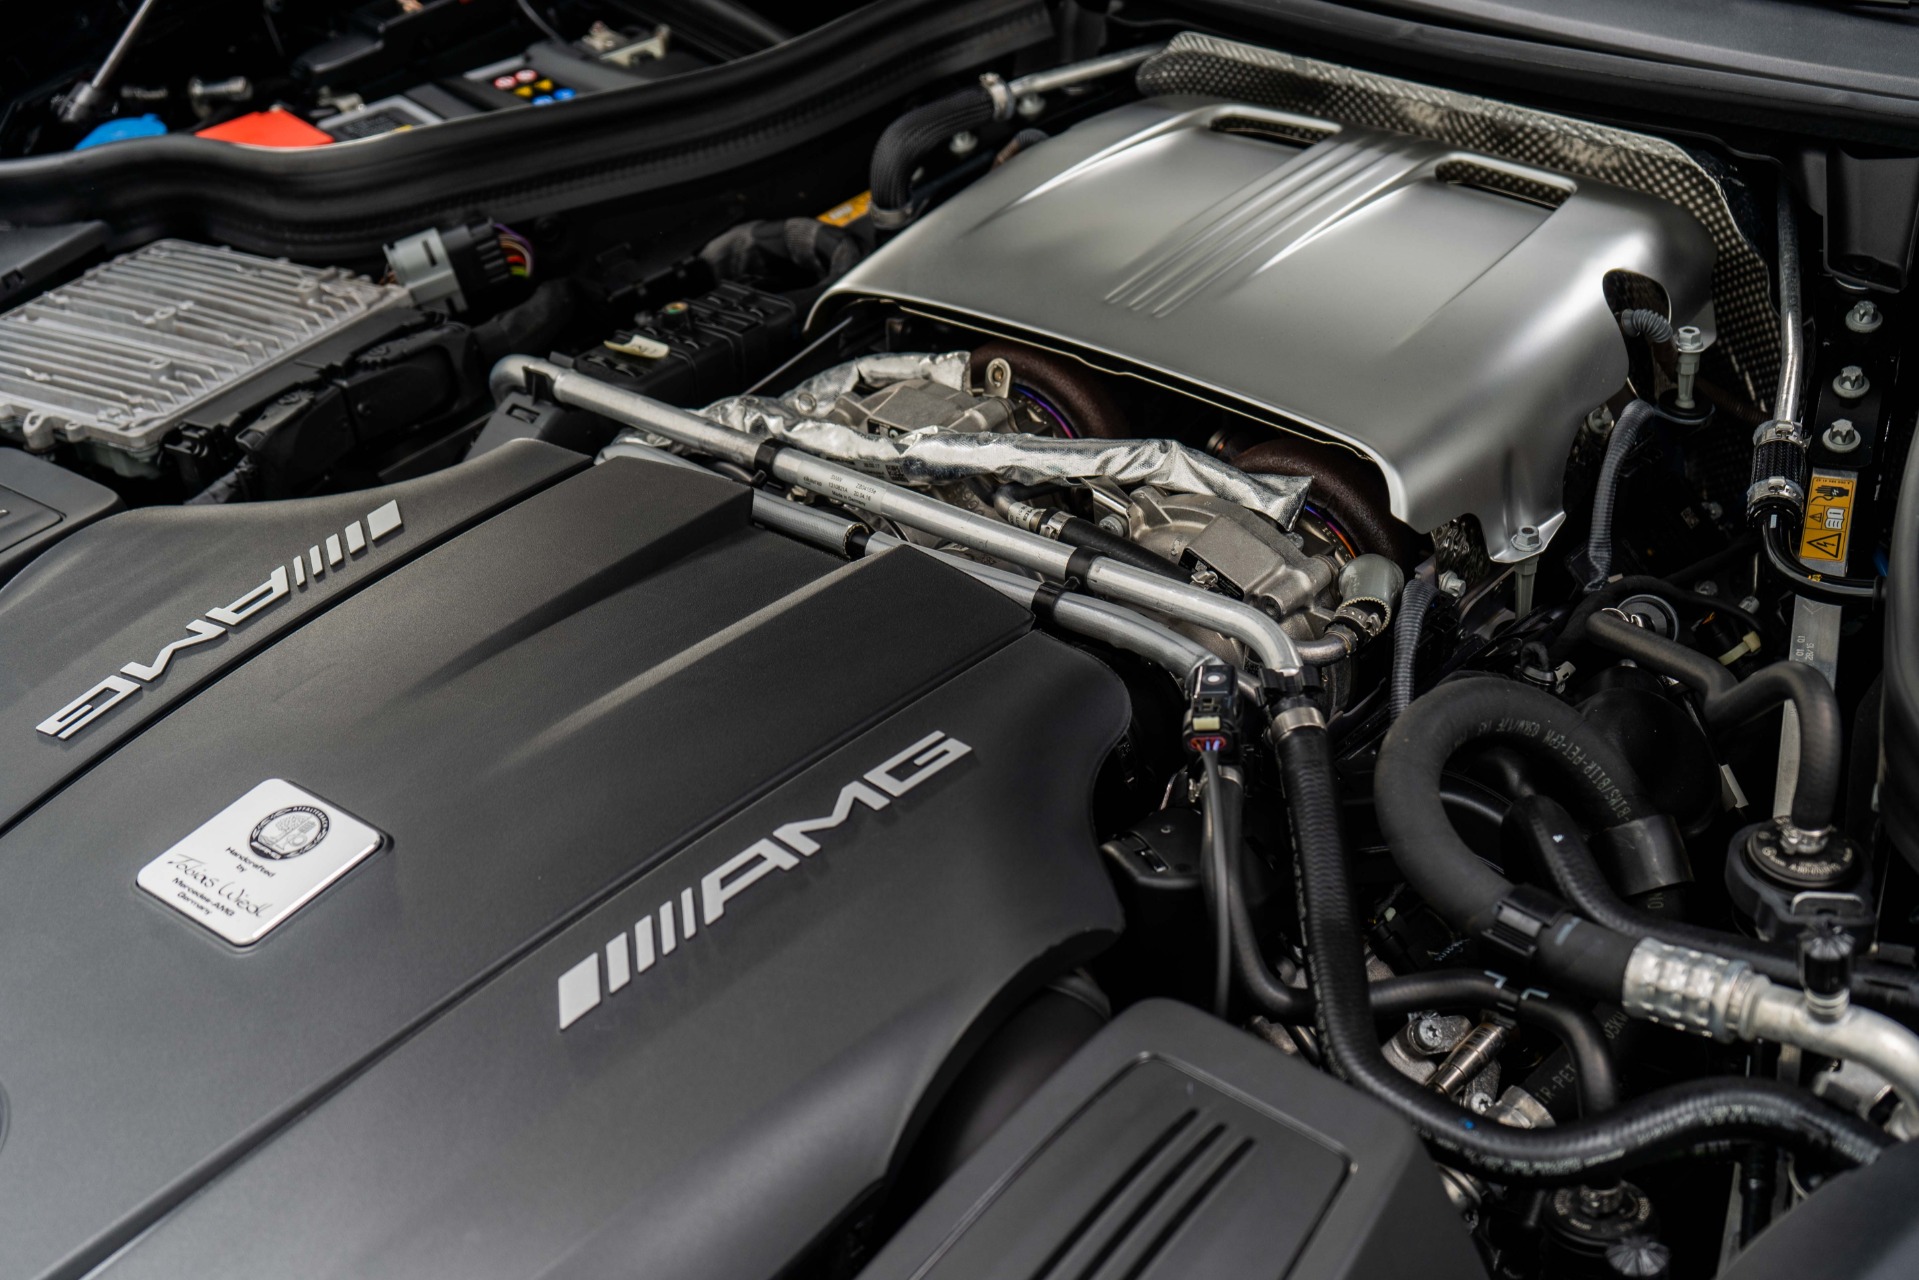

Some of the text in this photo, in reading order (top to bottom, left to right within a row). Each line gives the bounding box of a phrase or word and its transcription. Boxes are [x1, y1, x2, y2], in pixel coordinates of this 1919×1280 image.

[36, 566, 290, 741] AMG
[701, 730, 973, 926] AMG
[226, 846, 277, 878] Handcrafted
[236, 864, 246, 873] by
[172, 877, 235, 917] Mercedes-AMG
[178, 891, 212, 915] Germany
